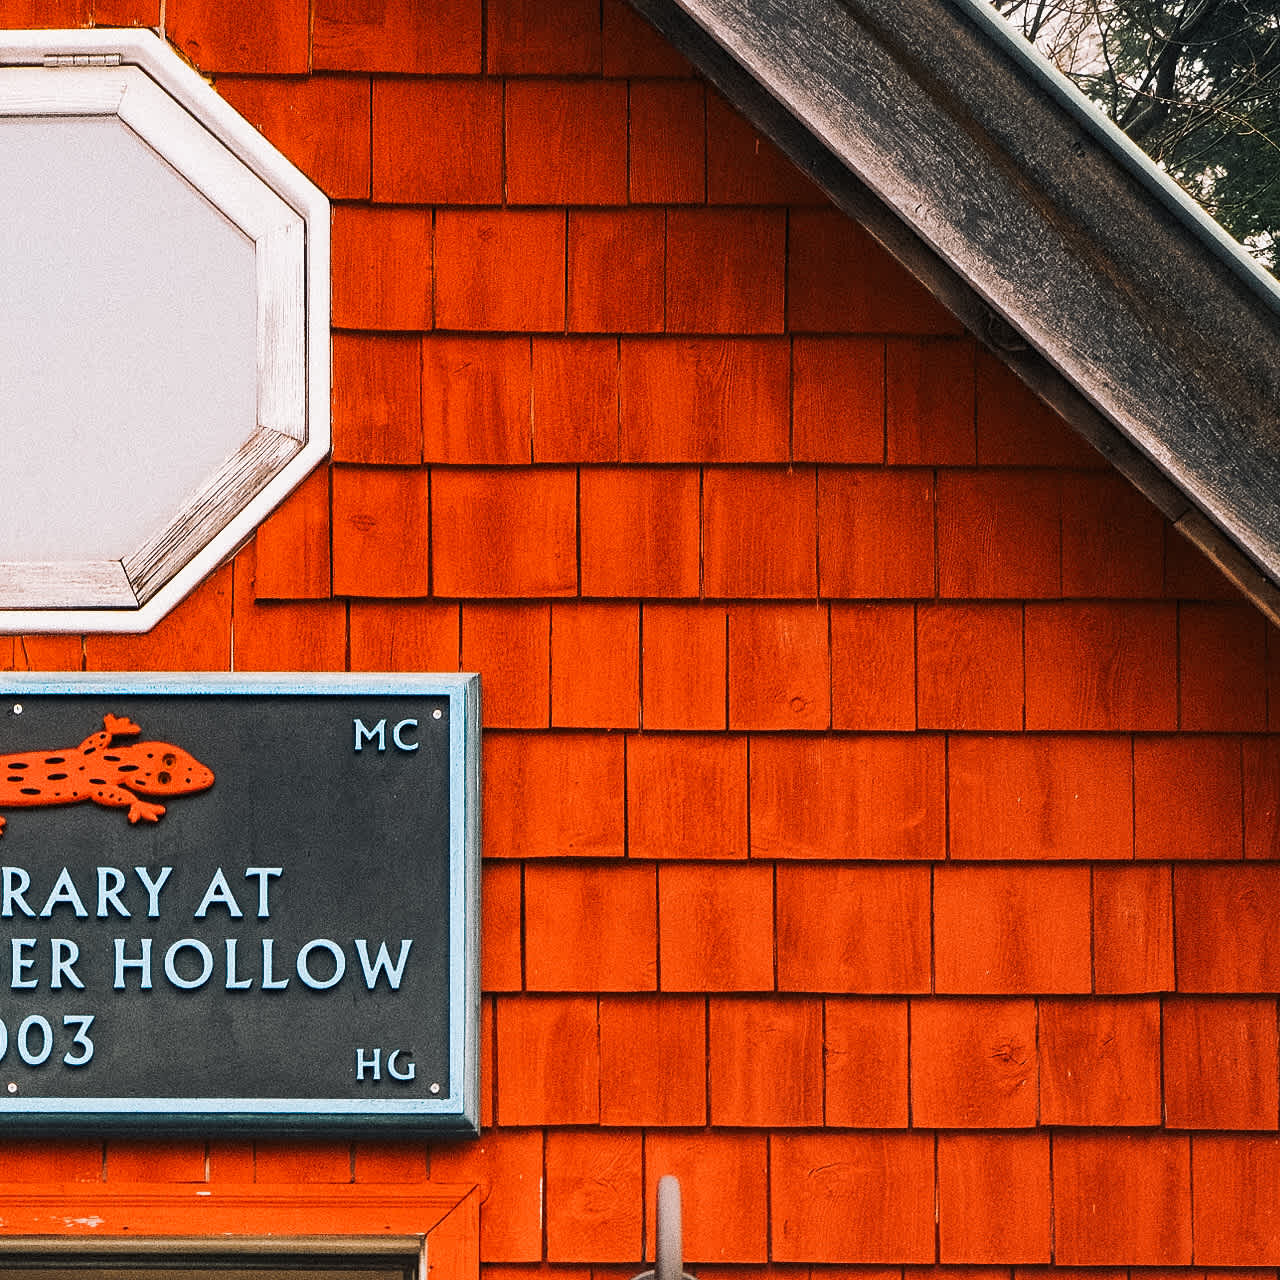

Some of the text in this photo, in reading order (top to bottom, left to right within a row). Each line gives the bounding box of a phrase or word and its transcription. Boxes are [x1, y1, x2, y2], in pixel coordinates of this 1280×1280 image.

[354, 719, 418, 750] MC
[195, 868, 282, 916] AT
[114, 939, 412, 988] HOLLOW
[355, 1049, 415, 1079] HG
